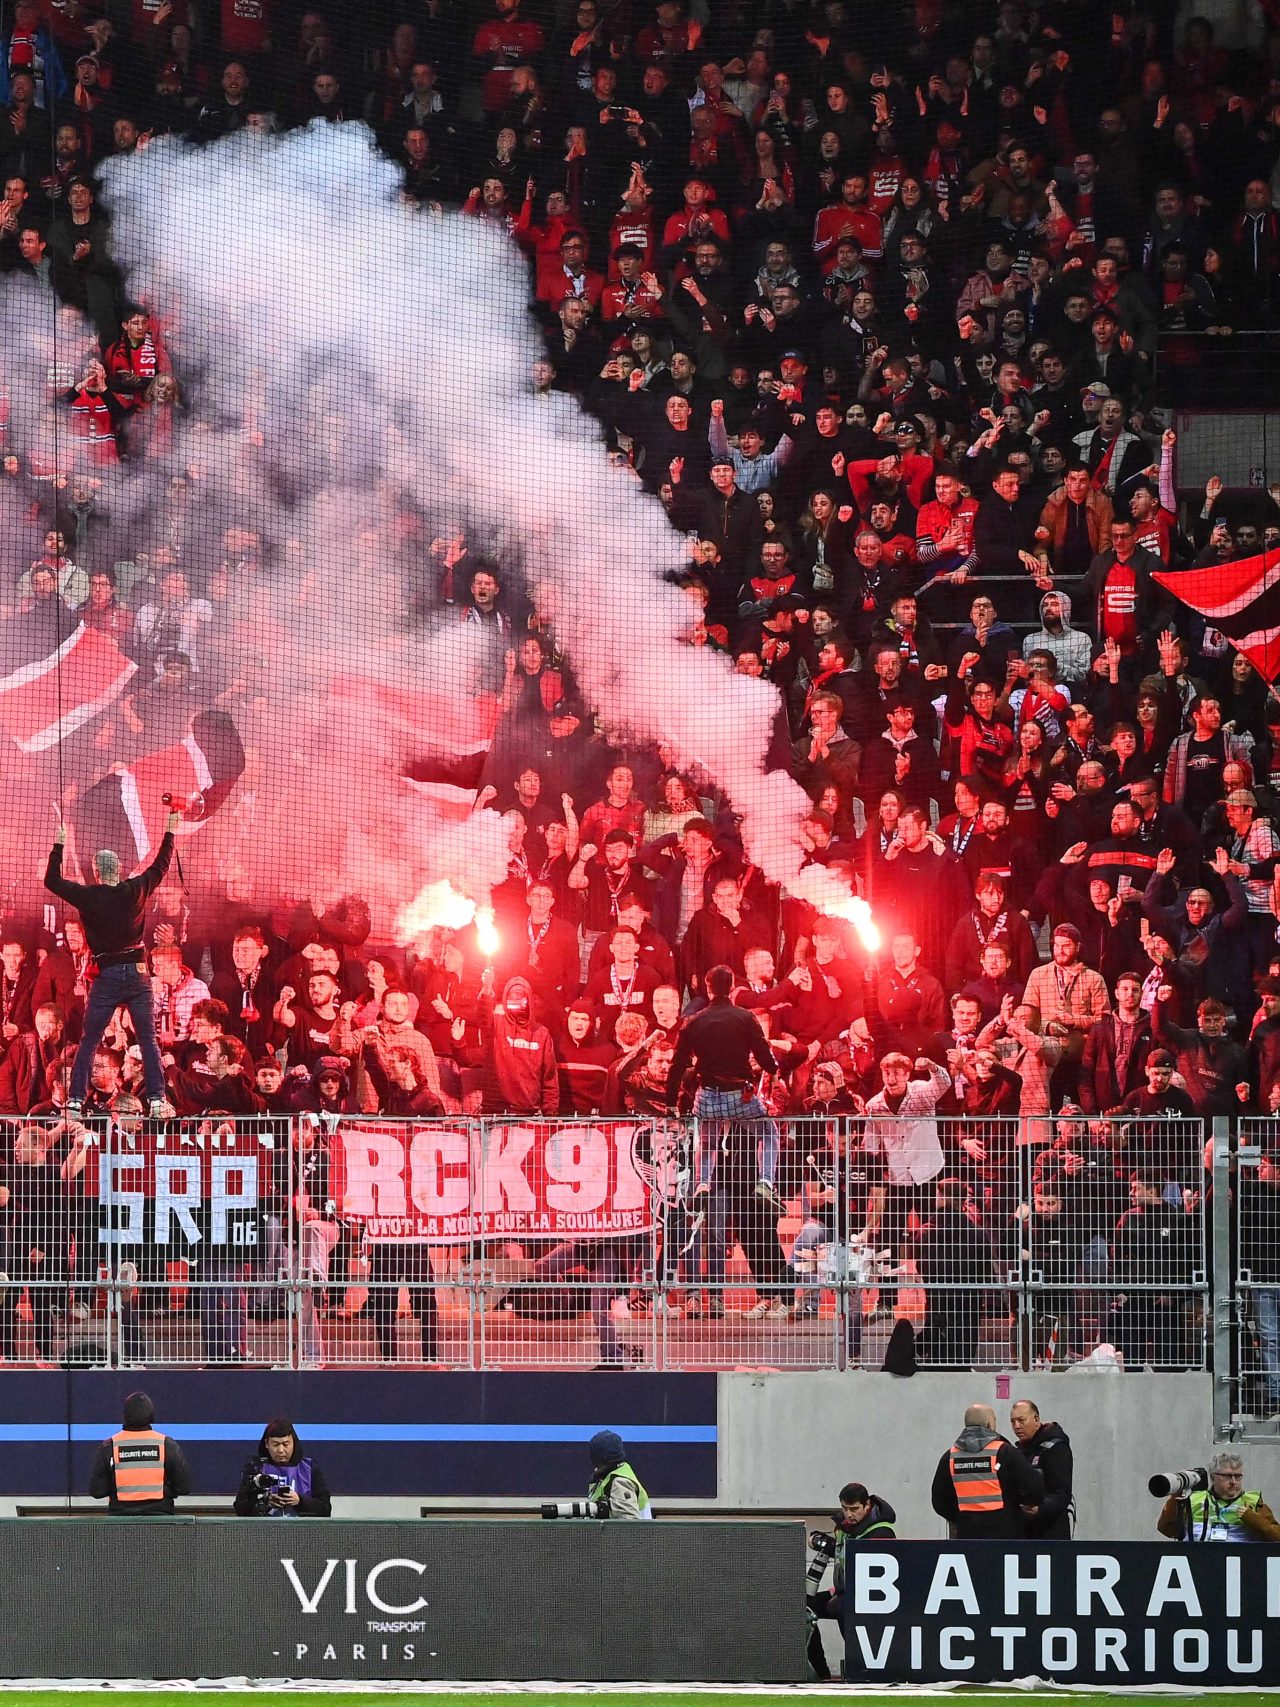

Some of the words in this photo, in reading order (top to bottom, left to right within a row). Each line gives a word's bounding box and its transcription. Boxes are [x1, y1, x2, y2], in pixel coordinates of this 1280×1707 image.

[98, 1154, 257, 1246] SRP
[233, 1221, 257, 1246] 06
[417, 1218, 439, 1236] LA
[443, 1215, 490, 1235] MORT
[495, 1213, 525, 1230] QUE
[530, 1213, 550, 1229] LA
[556, 1211, 643, 1229] SOUILLURE
[280, 1558, 429, 1615] VIC
[367, 1621, 426, 1633] TRANSPORT
[855, 1625, 1263, 1674] VICTORIOU
